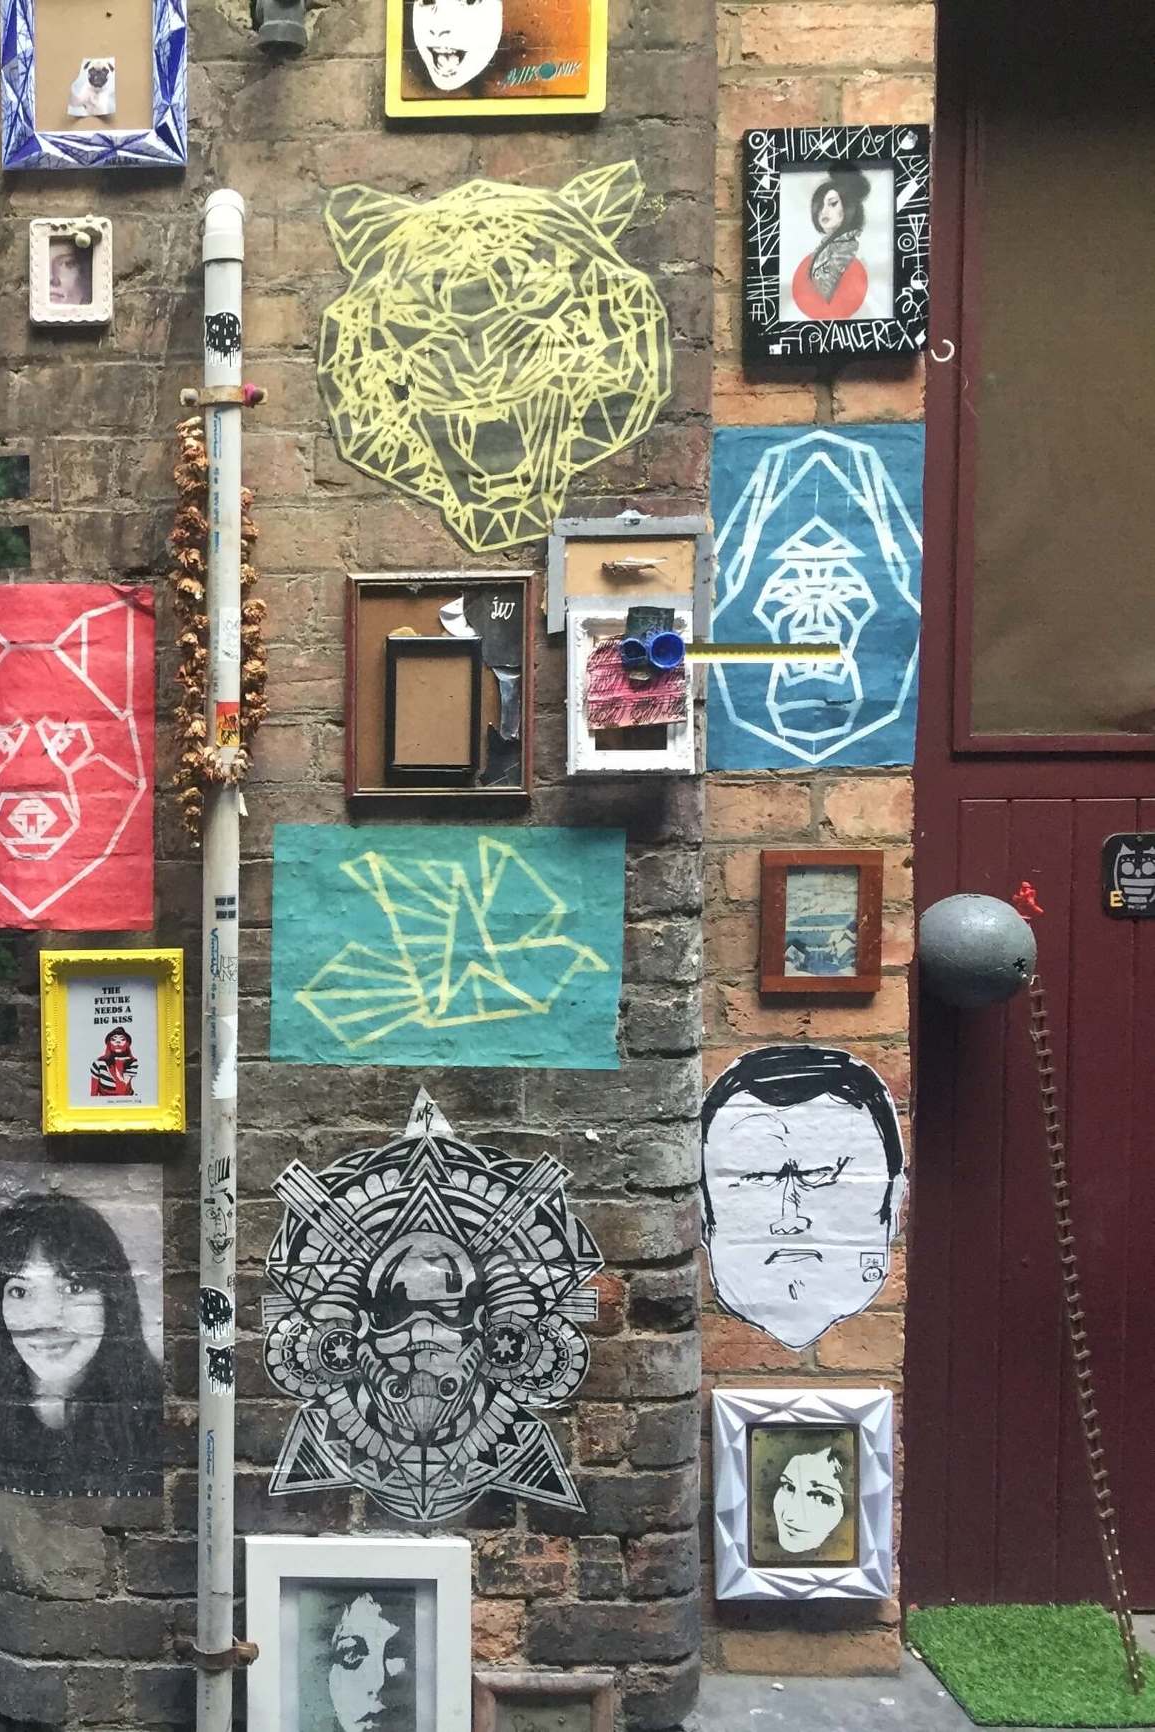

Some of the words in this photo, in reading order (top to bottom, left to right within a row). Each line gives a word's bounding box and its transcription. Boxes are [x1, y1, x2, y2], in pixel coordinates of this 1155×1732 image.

[102, 986, 121, 995] THE
[94, 996, 131, 1005] FUTURE
[95, 1006, 123, 1015] NEEDS
[93, 1017, 110, 1025] BIG
[111, 1016, 133, 1024] KISS
